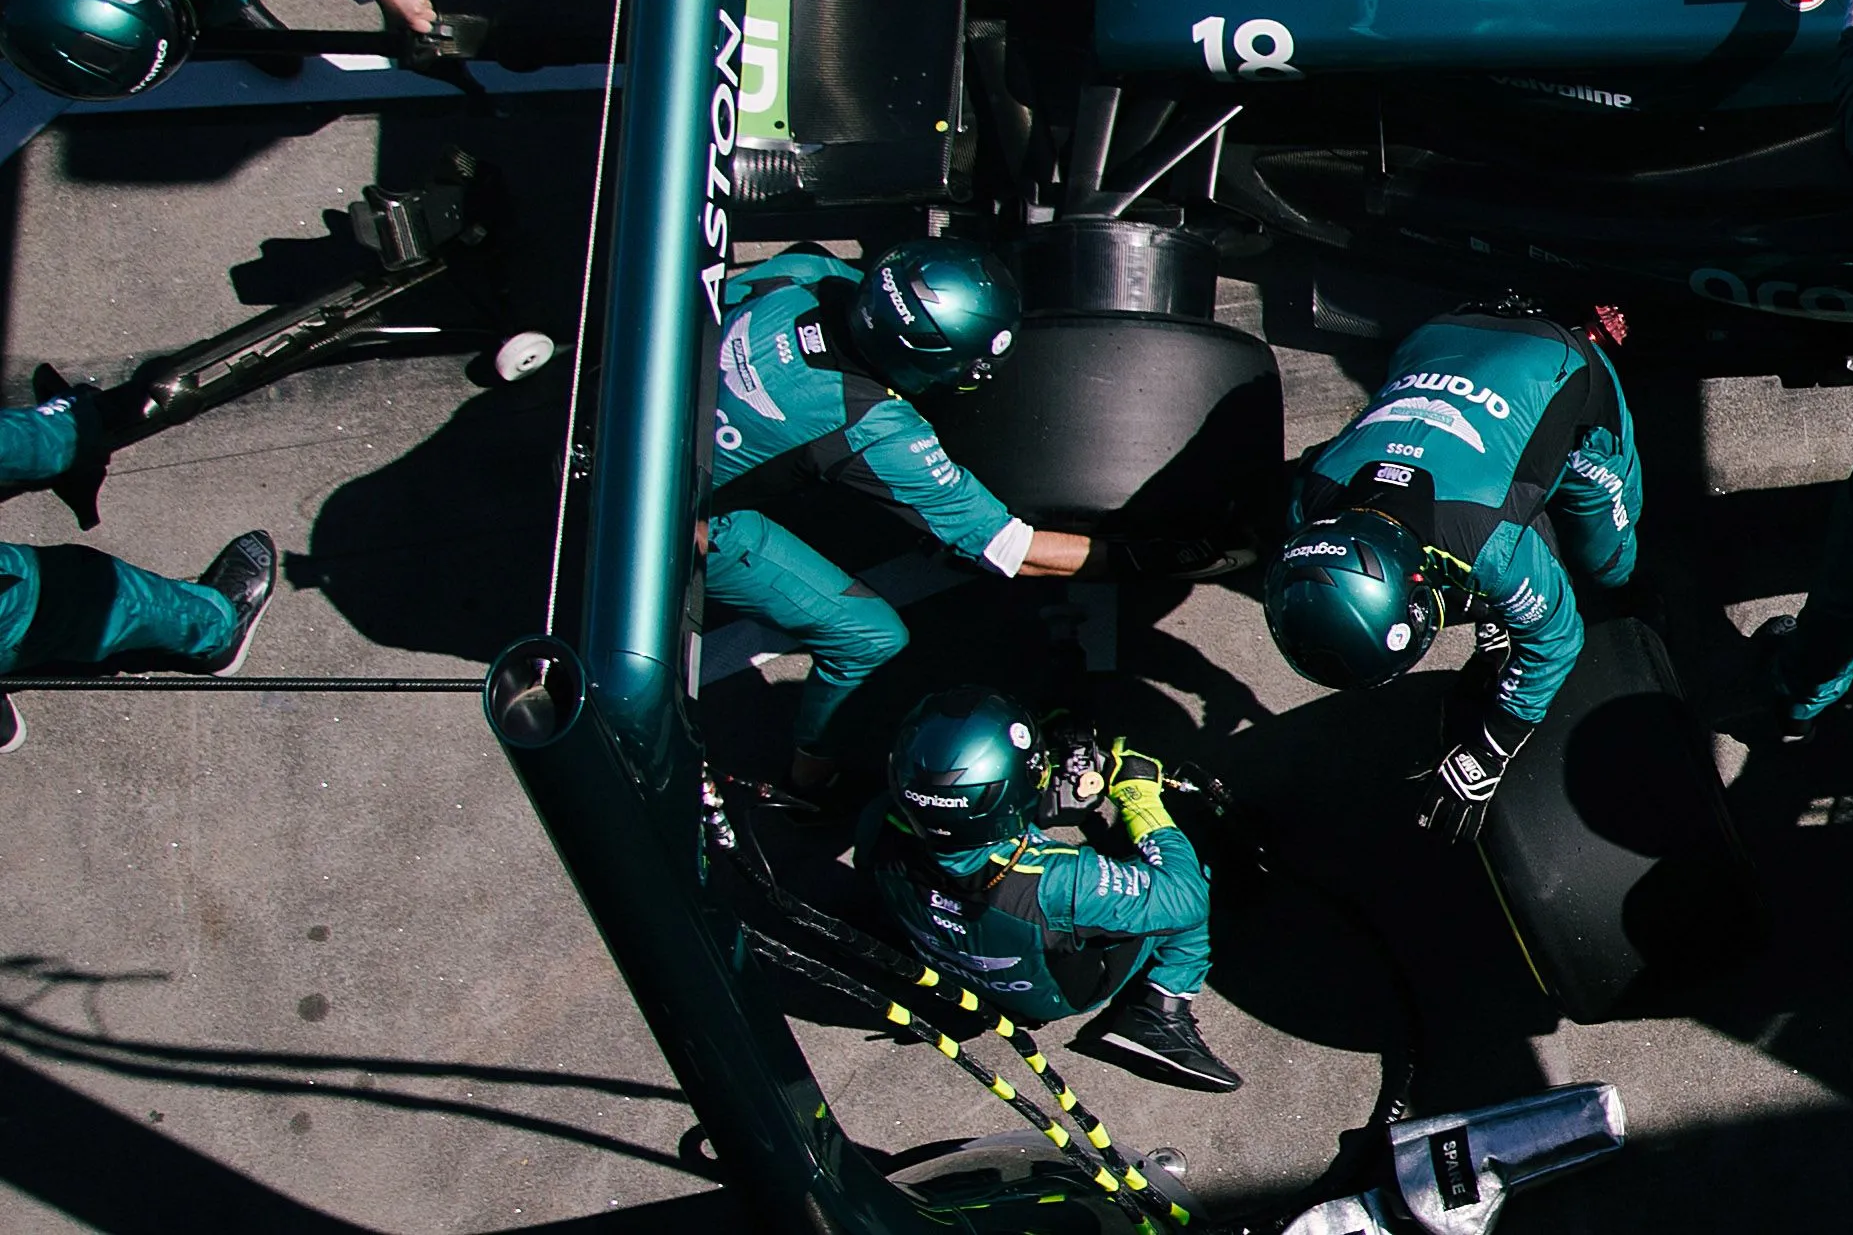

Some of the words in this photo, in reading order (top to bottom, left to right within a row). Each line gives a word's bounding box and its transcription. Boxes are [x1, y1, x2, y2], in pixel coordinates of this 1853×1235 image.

[1192, 15, 1303, 83] 18
[699, 8, 745, 327] ASTON
[880, 267, 916, 325] cognizant
[1375, 464, 1415, 487] OMP
[1385, 443, 1423, 459] BOSS
[904, 789, 969, 809] cognizant
[1442, 1139, 1467, 1196] SPARE
